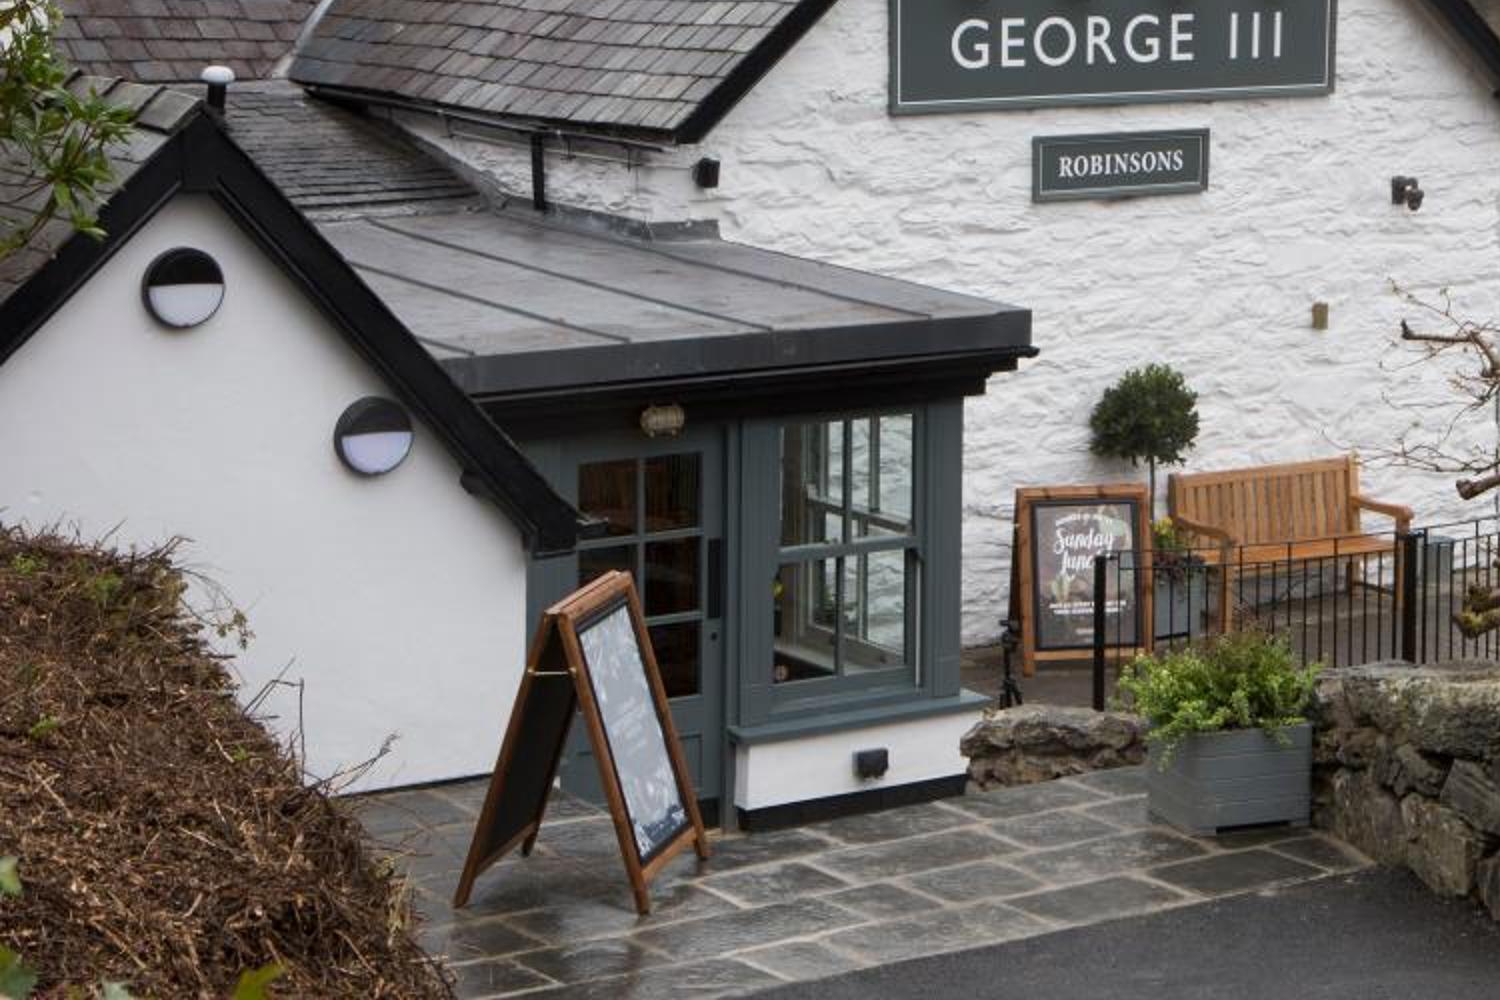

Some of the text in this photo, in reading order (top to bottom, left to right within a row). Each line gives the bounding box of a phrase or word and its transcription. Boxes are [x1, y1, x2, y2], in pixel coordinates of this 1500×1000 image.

[951, 10, 1282, 69] GEORGE III
[1058, 149, 1184, 178] ROBINSONS
[1053, 528, 1113, 556] Sunday
